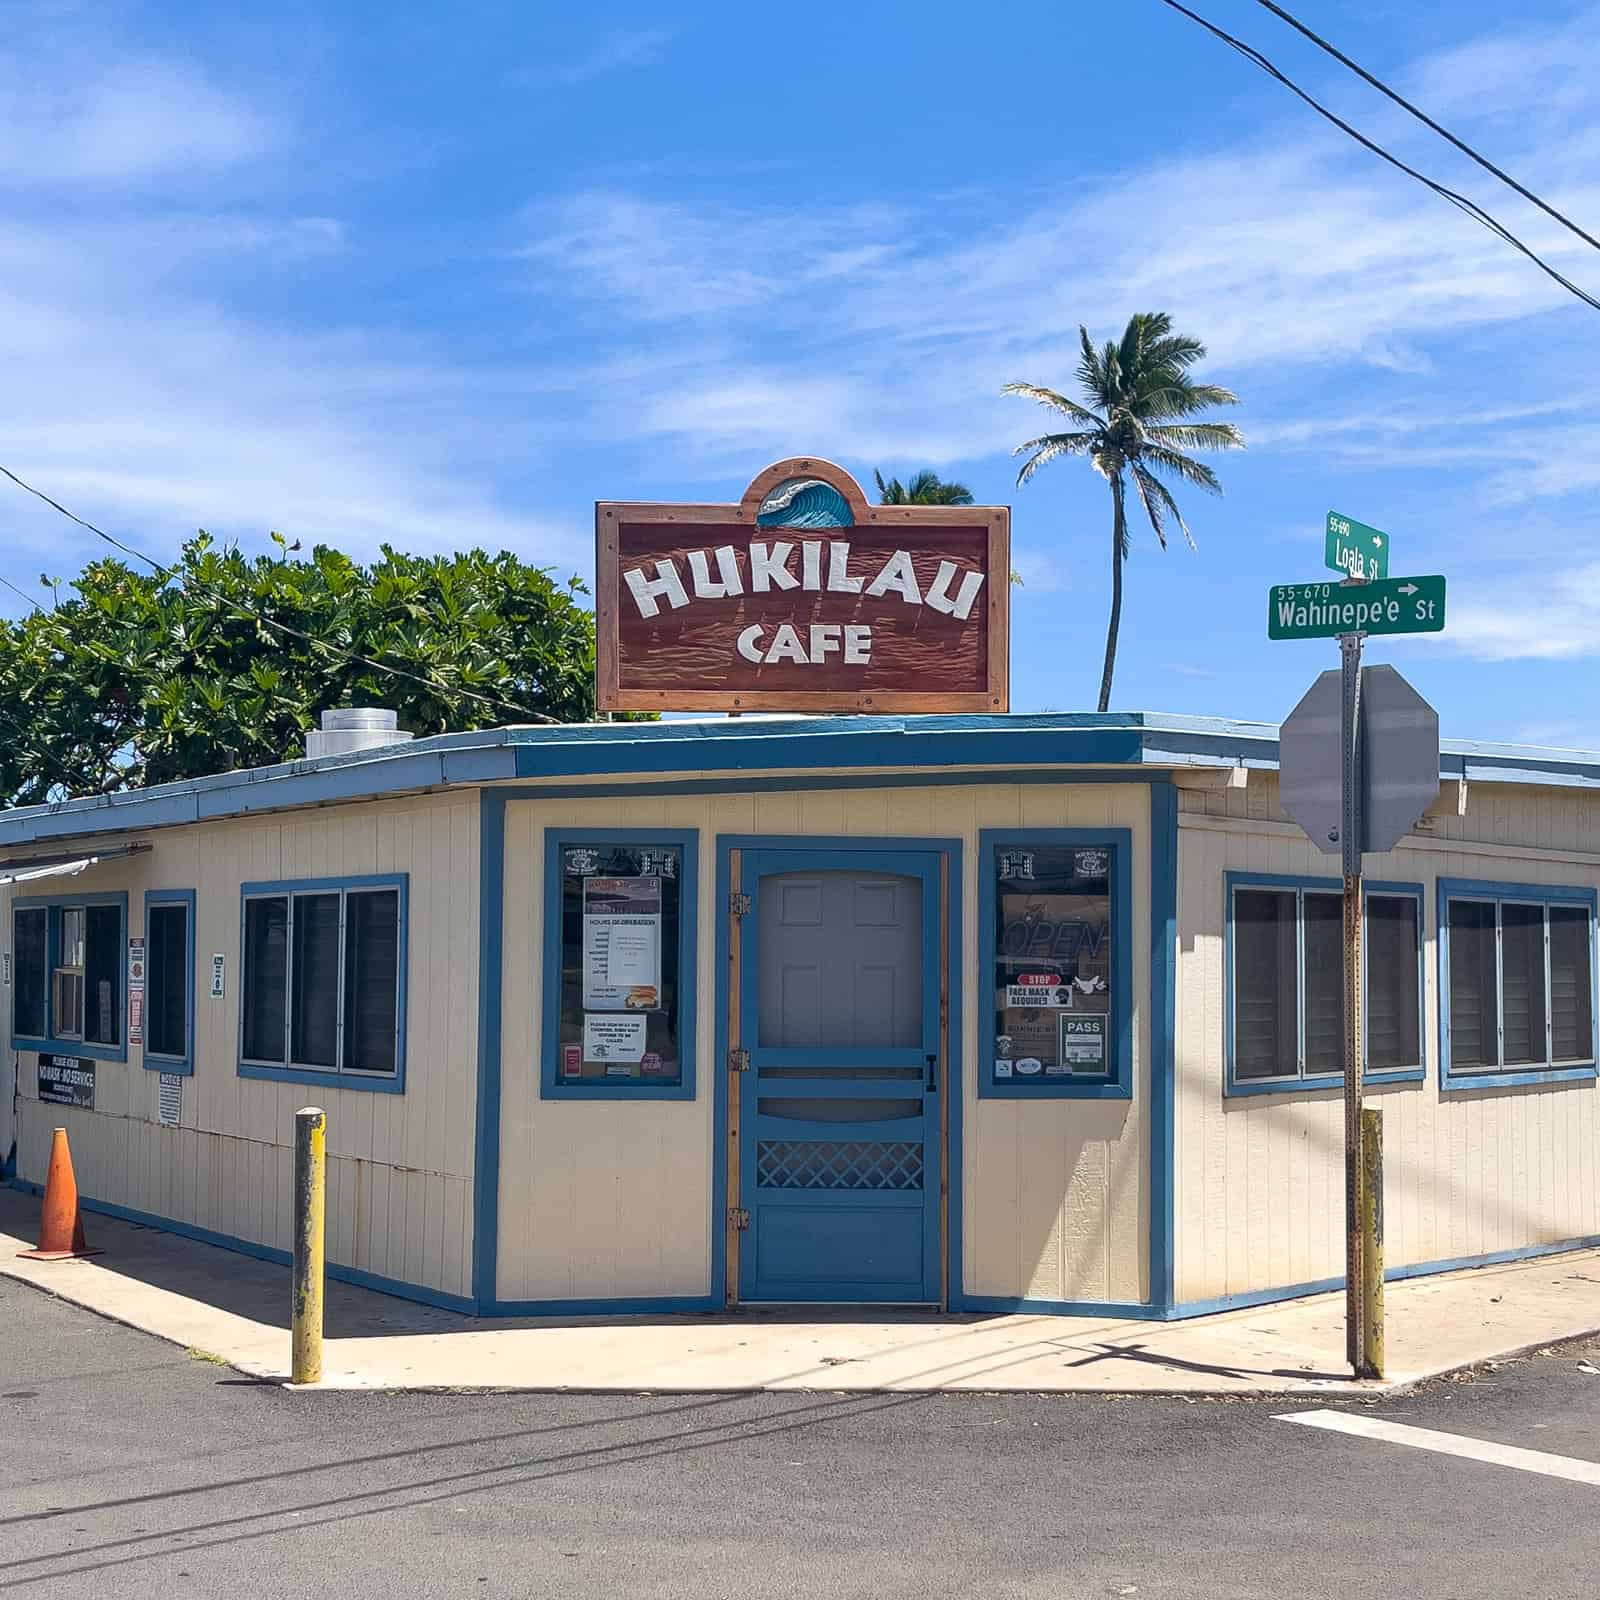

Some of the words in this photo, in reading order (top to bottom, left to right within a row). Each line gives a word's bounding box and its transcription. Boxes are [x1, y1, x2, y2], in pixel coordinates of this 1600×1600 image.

[1329, 517, 1350, 536] 55-690
[1335, 539, 1364, 575] Loala
[1369, 558, 1378, 580] St
[623, 541, 985, 621] HUKILAU
[1278, 584, 1330, 601] 55-670
[1278, 596, 1400, 630] Wahinepe'e
[1415, 599, 1435, 620] St
[737, 623, 872, 665] CAFE
[1003, 920, 1105, 959] OPEN
[1028, 975, 1050, 984] STOP
[1009, 988, 1026, 996] FACE
[1028, 988, 1050, 996] MASK
[1011, 997, 1048, 1005] REQUIRED
[1067, 1022, 1100, 1032] PASS
[40, 1066, 46, 1080] NO
[47, 1066, 60, 1082] MASK
[63, 1068, 71, 1084] NO
[72, 1070, 94, 1088] SERVICE
[161, 1074, 180, 1086] NOTICE
